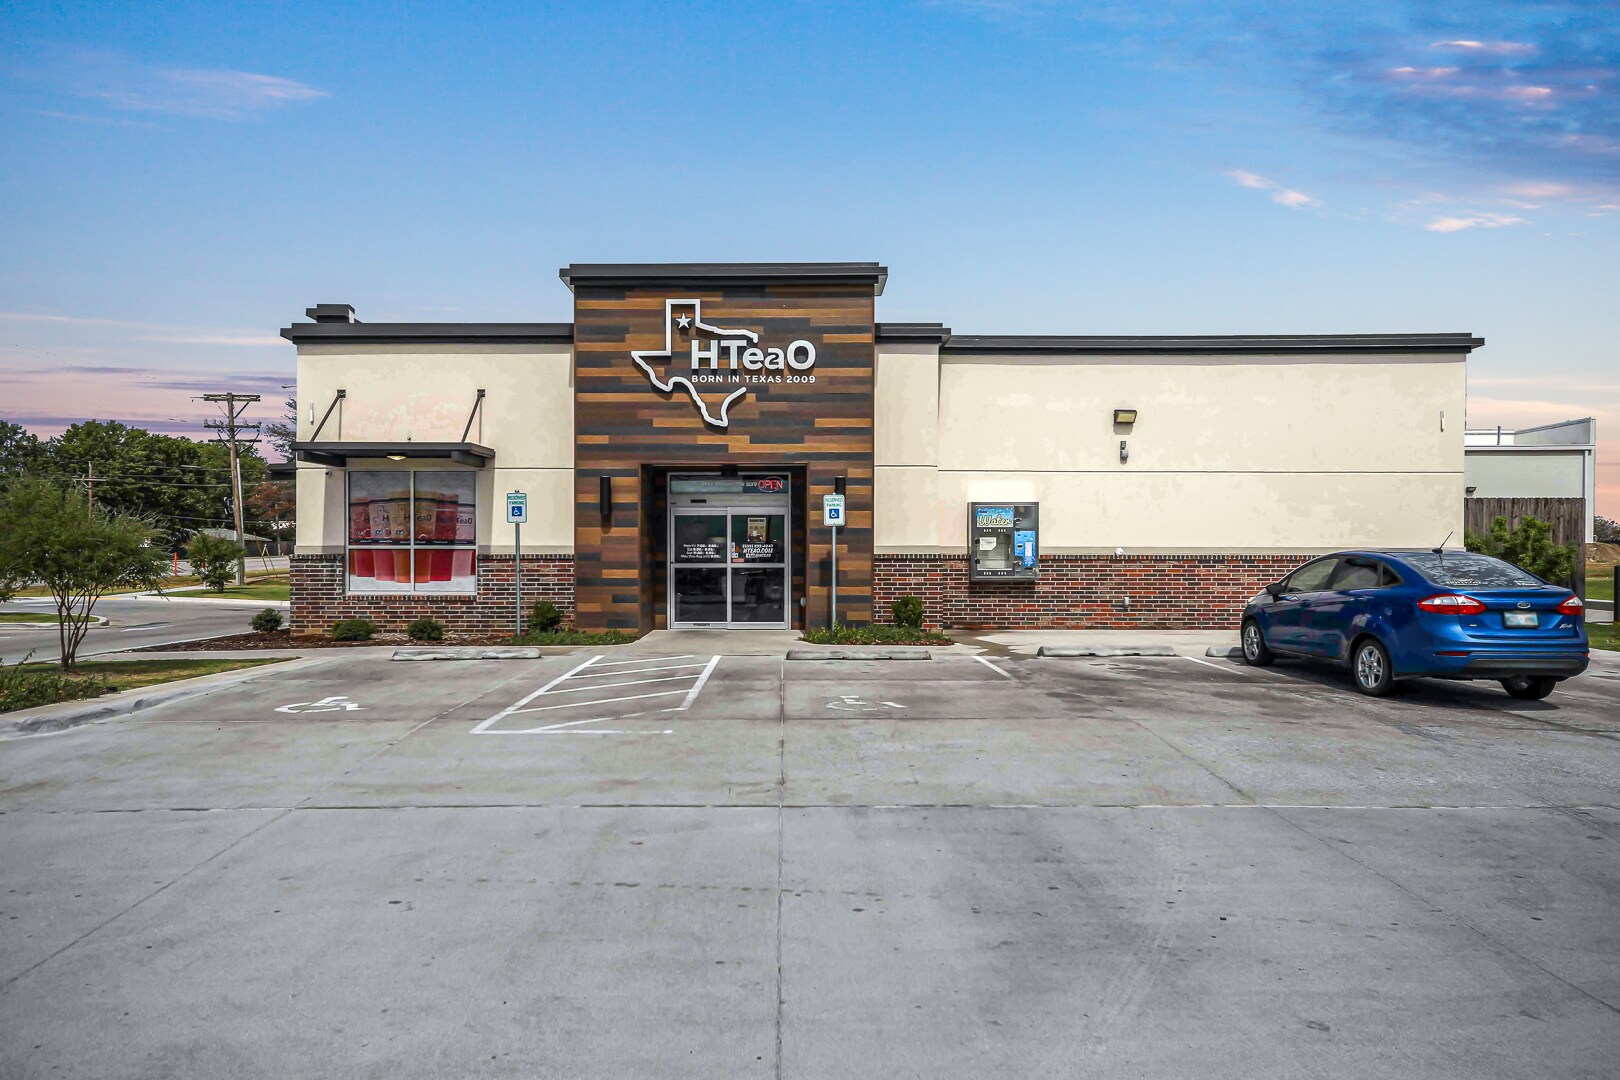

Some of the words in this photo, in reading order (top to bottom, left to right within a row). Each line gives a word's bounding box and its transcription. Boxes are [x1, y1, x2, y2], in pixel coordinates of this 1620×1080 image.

[691, 339, 816, 370] HTeaO
[692, 375, 723, 383] BORN
[728, 375, 739, 383] IN
[744, 375, 782, 383] TEXAS
[786, 375, 816, 383] 2009
[758, 480, 783, 490] OPEN
[979, 513, 1011, 526] Water
